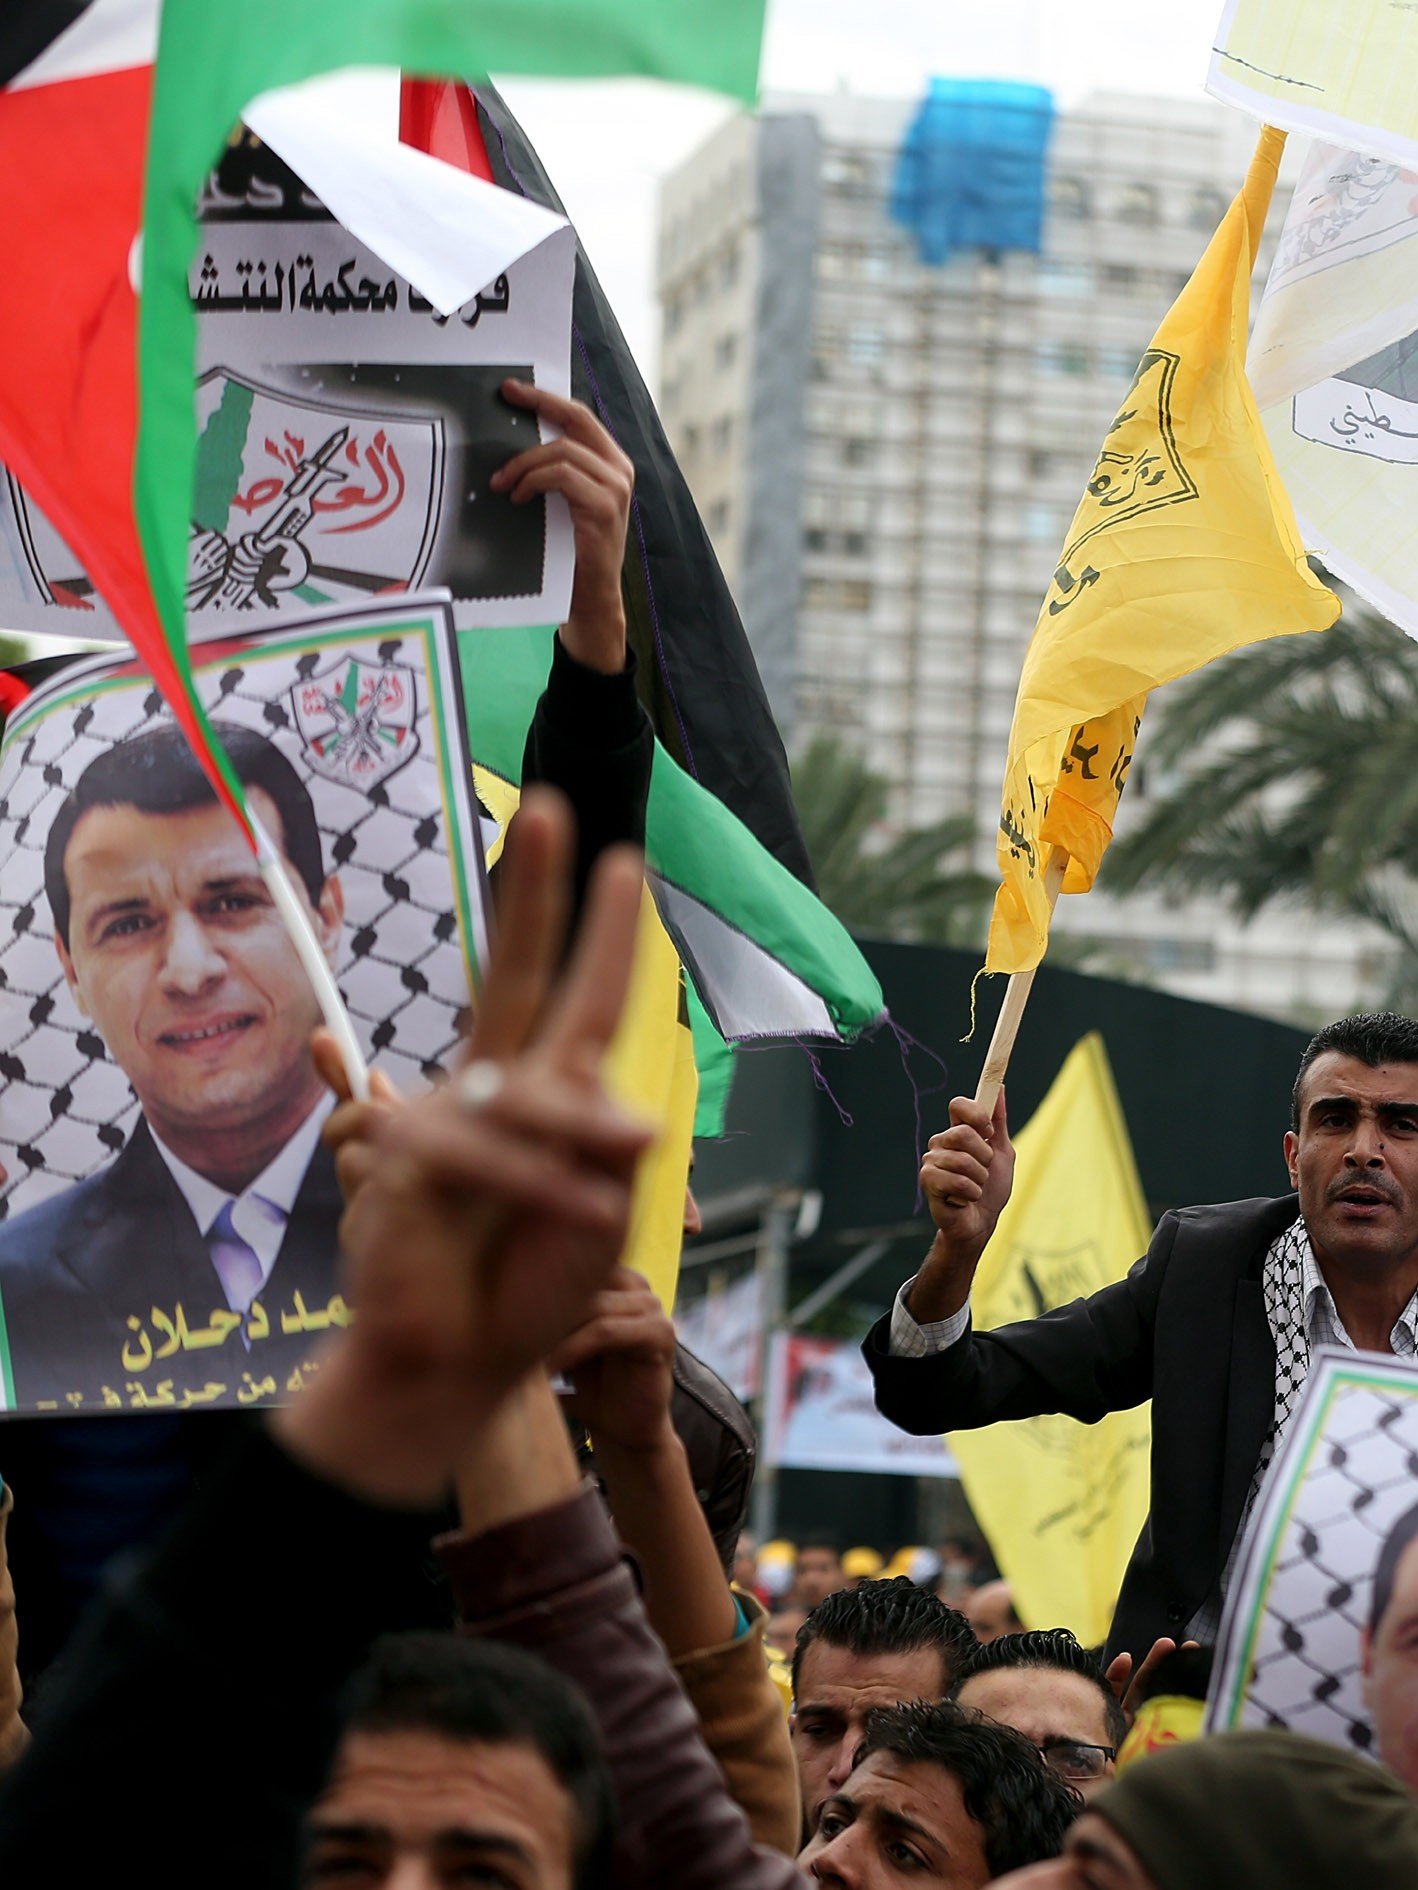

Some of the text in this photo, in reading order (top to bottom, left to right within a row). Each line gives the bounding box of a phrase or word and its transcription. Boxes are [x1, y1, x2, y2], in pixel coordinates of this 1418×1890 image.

[187, 252, 297, 315] النتش
[299, 252, 398, 315] محكمة
[120, 1300, 270, 1373] دحلان
[237, 1372, 277, 1404] من
